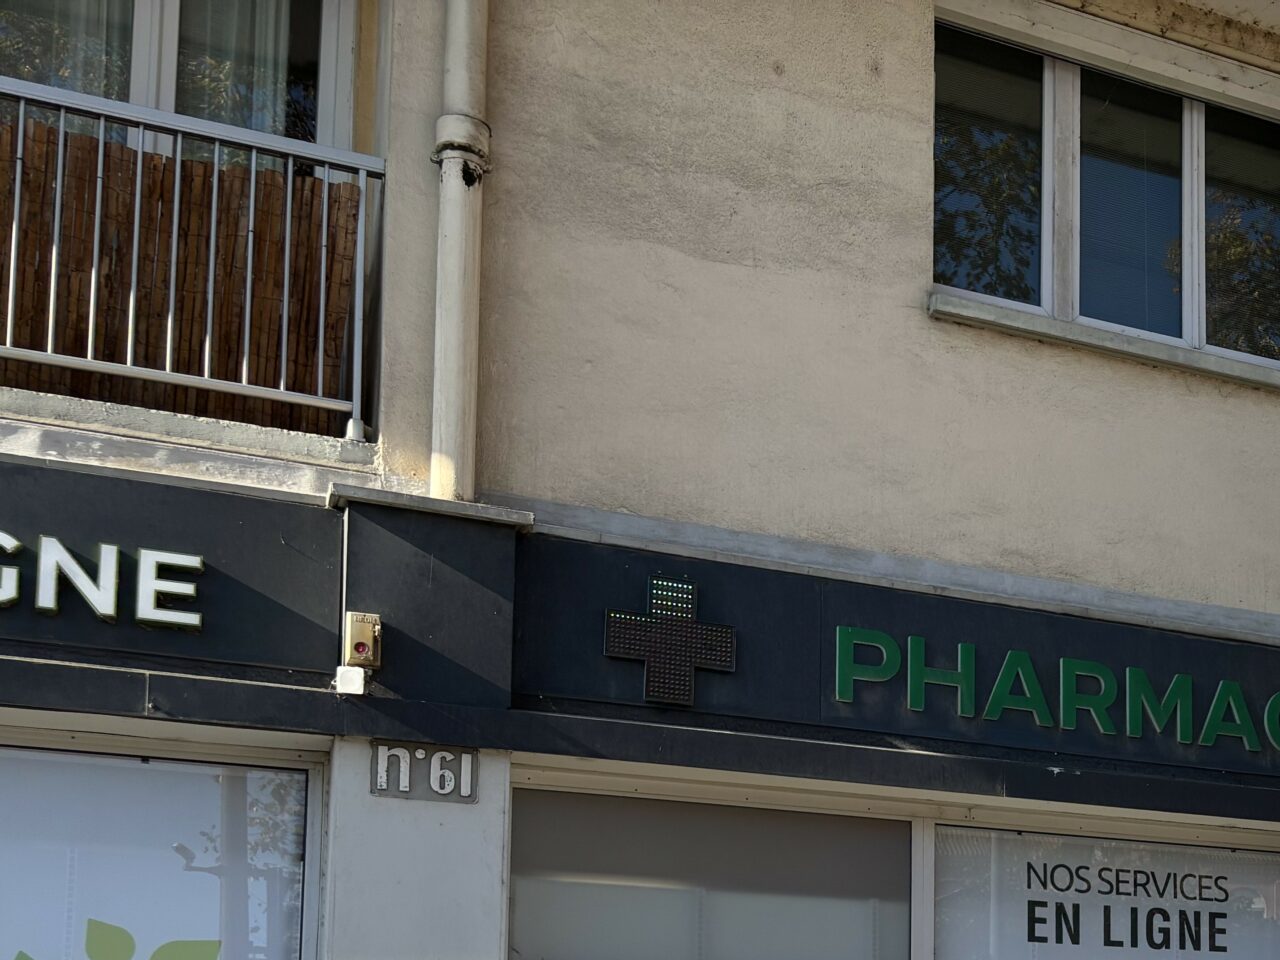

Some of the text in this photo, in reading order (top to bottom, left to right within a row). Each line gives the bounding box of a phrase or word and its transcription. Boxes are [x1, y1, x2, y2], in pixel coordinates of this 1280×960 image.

[1027, 861, 1229, 902] NOS SERVICES
[1027, 900, 1228, 952] EN LIGNE
